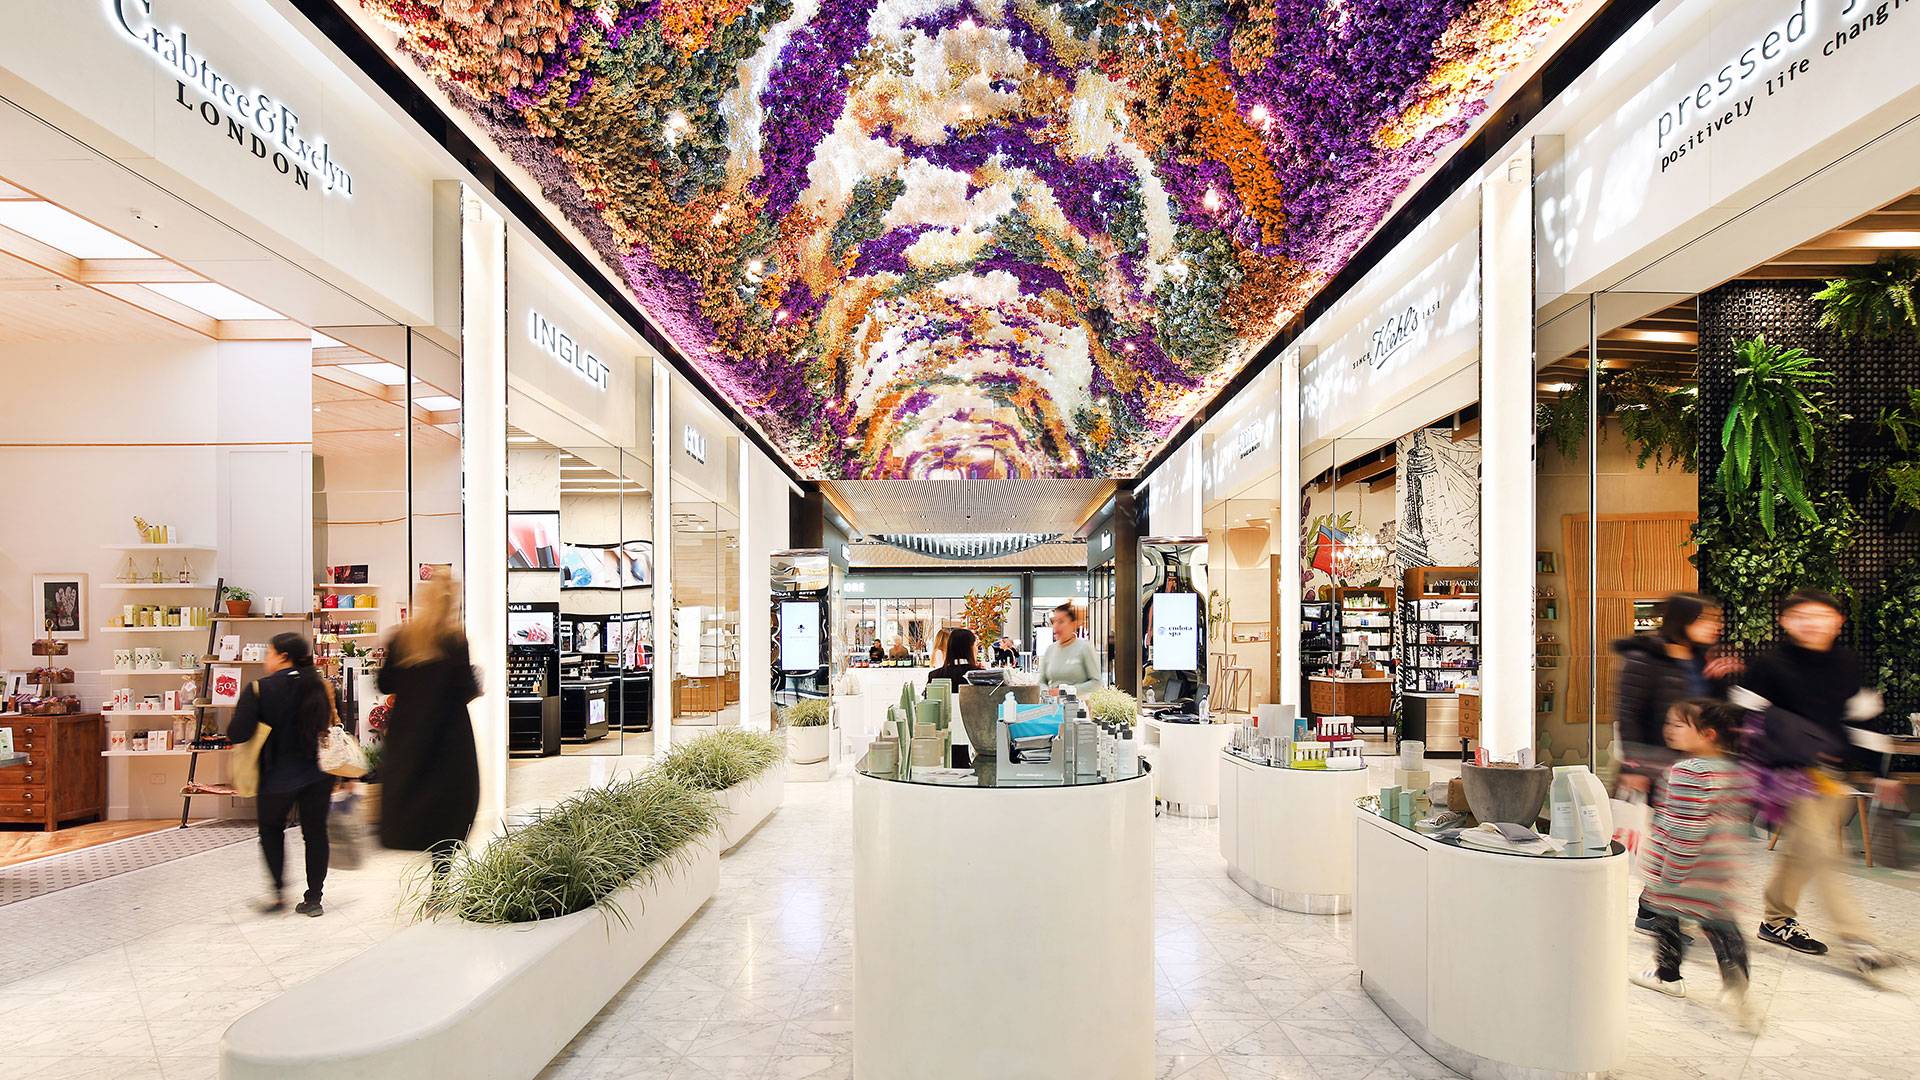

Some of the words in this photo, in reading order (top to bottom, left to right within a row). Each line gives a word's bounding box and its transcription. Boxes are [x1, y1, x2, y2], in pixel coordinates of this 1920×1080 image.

[1658, 0, 1806, 149] pressed
[1661, 96, 1754, 173] positively
[1766, 58, 1810, 97] life
[176, 79, 310, 191] LONDON
[533, 312, 610, 389] INGLOT
[1352, 351, 1371, 370] SINCE
[1369, 306, 1419, 370] Kiehl's
